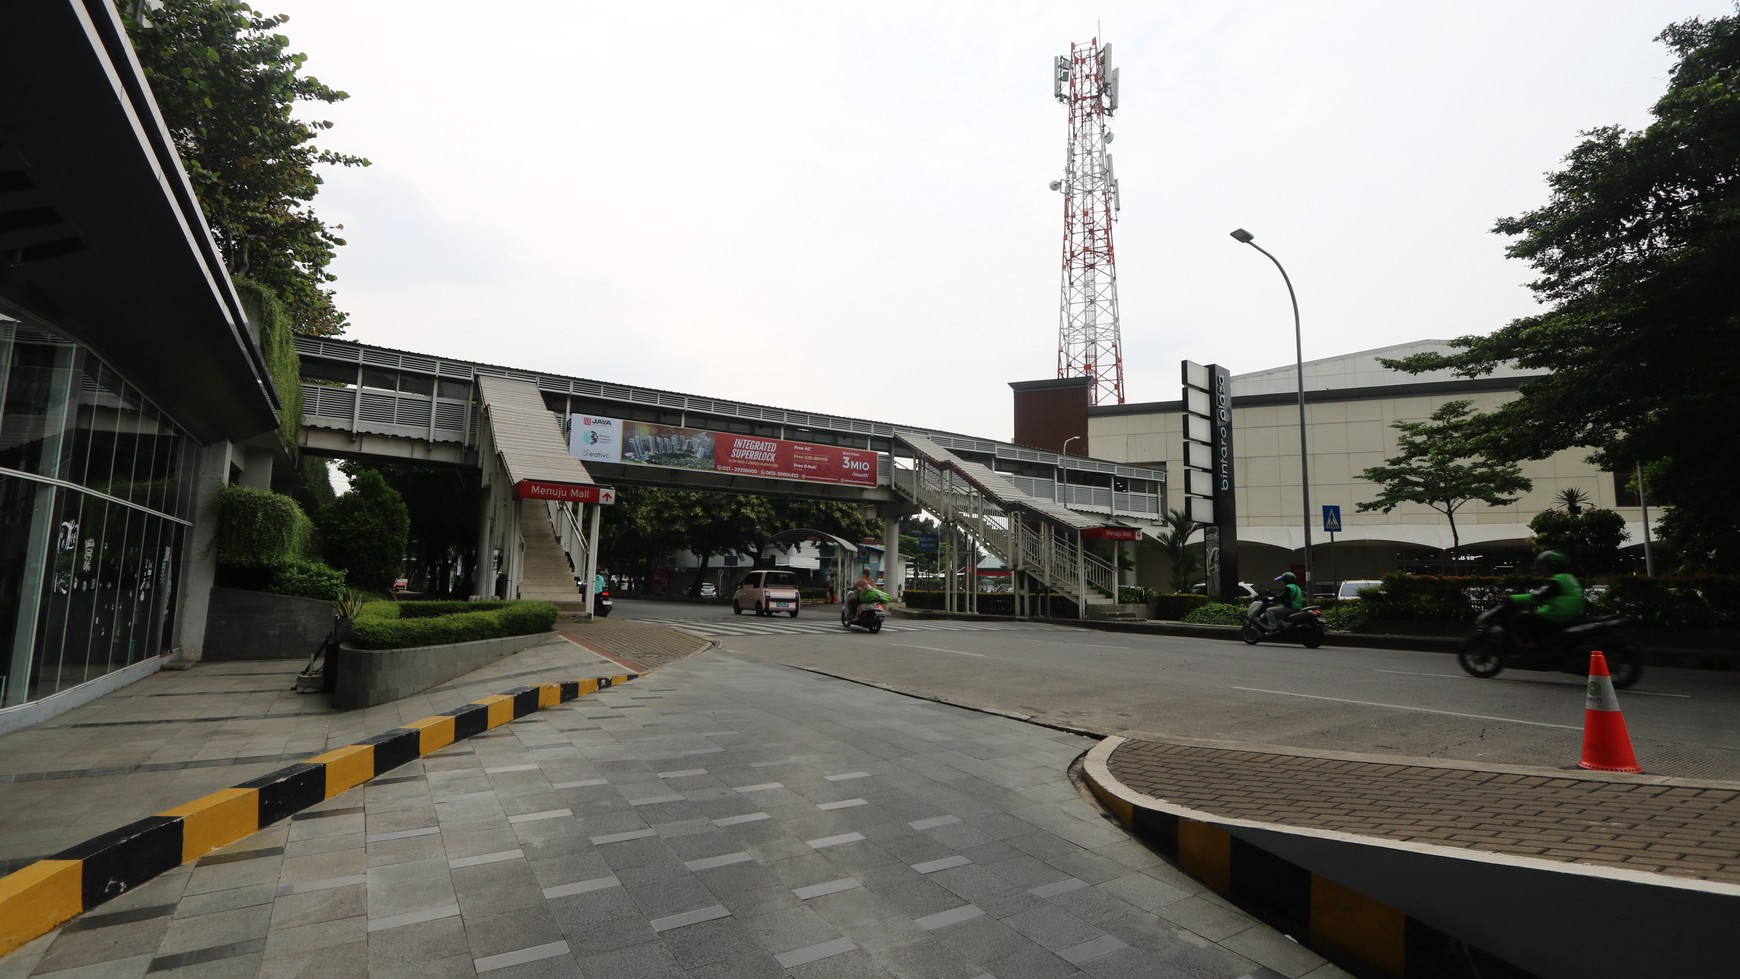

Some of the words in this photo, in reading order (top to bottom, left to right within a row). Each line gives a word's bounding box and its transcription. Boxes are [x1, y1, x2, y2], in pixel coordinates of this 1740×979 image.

[1217, 374, 1227, 422] plaza
[591, 418, 612, 426] JAYA
[733, 438, 777, 453] INTEGRATED
[730, 448, 776, 462] SUPERBLOCK
[1219, 427, 1229, 491] bintaro
[531, 486, 567, 498] Menuju
[570, 489, 590, 499] Mall
